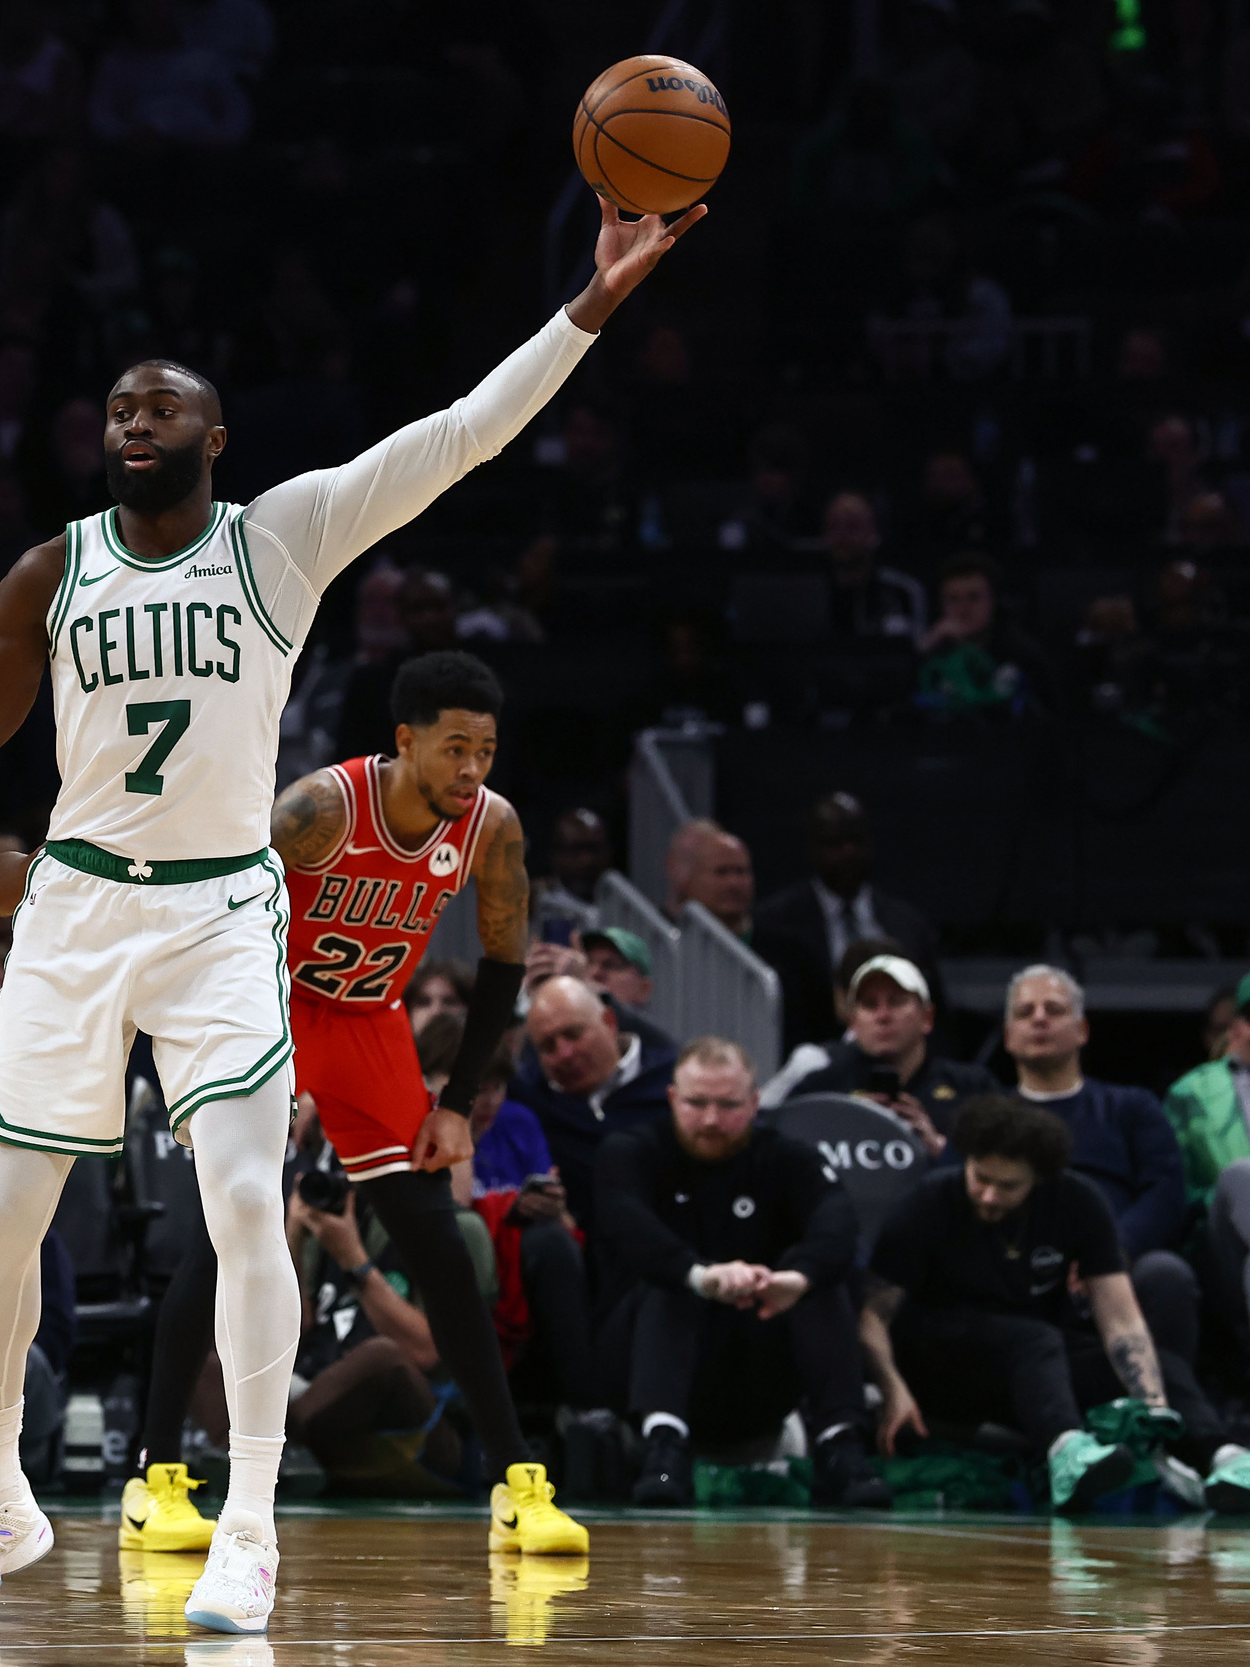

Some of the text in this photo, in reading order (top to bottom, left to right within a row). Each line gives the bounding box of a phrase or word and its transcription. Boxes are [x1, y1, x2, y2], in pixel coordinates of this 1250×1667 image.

[184, 564, 233, 579] Amica
[70, 602, 241, 693] CELTICS
[125, 700, 191, 795] 7
[292, 932, 411, 1001] 22
[817, 1139, 915, 1170] MCO
